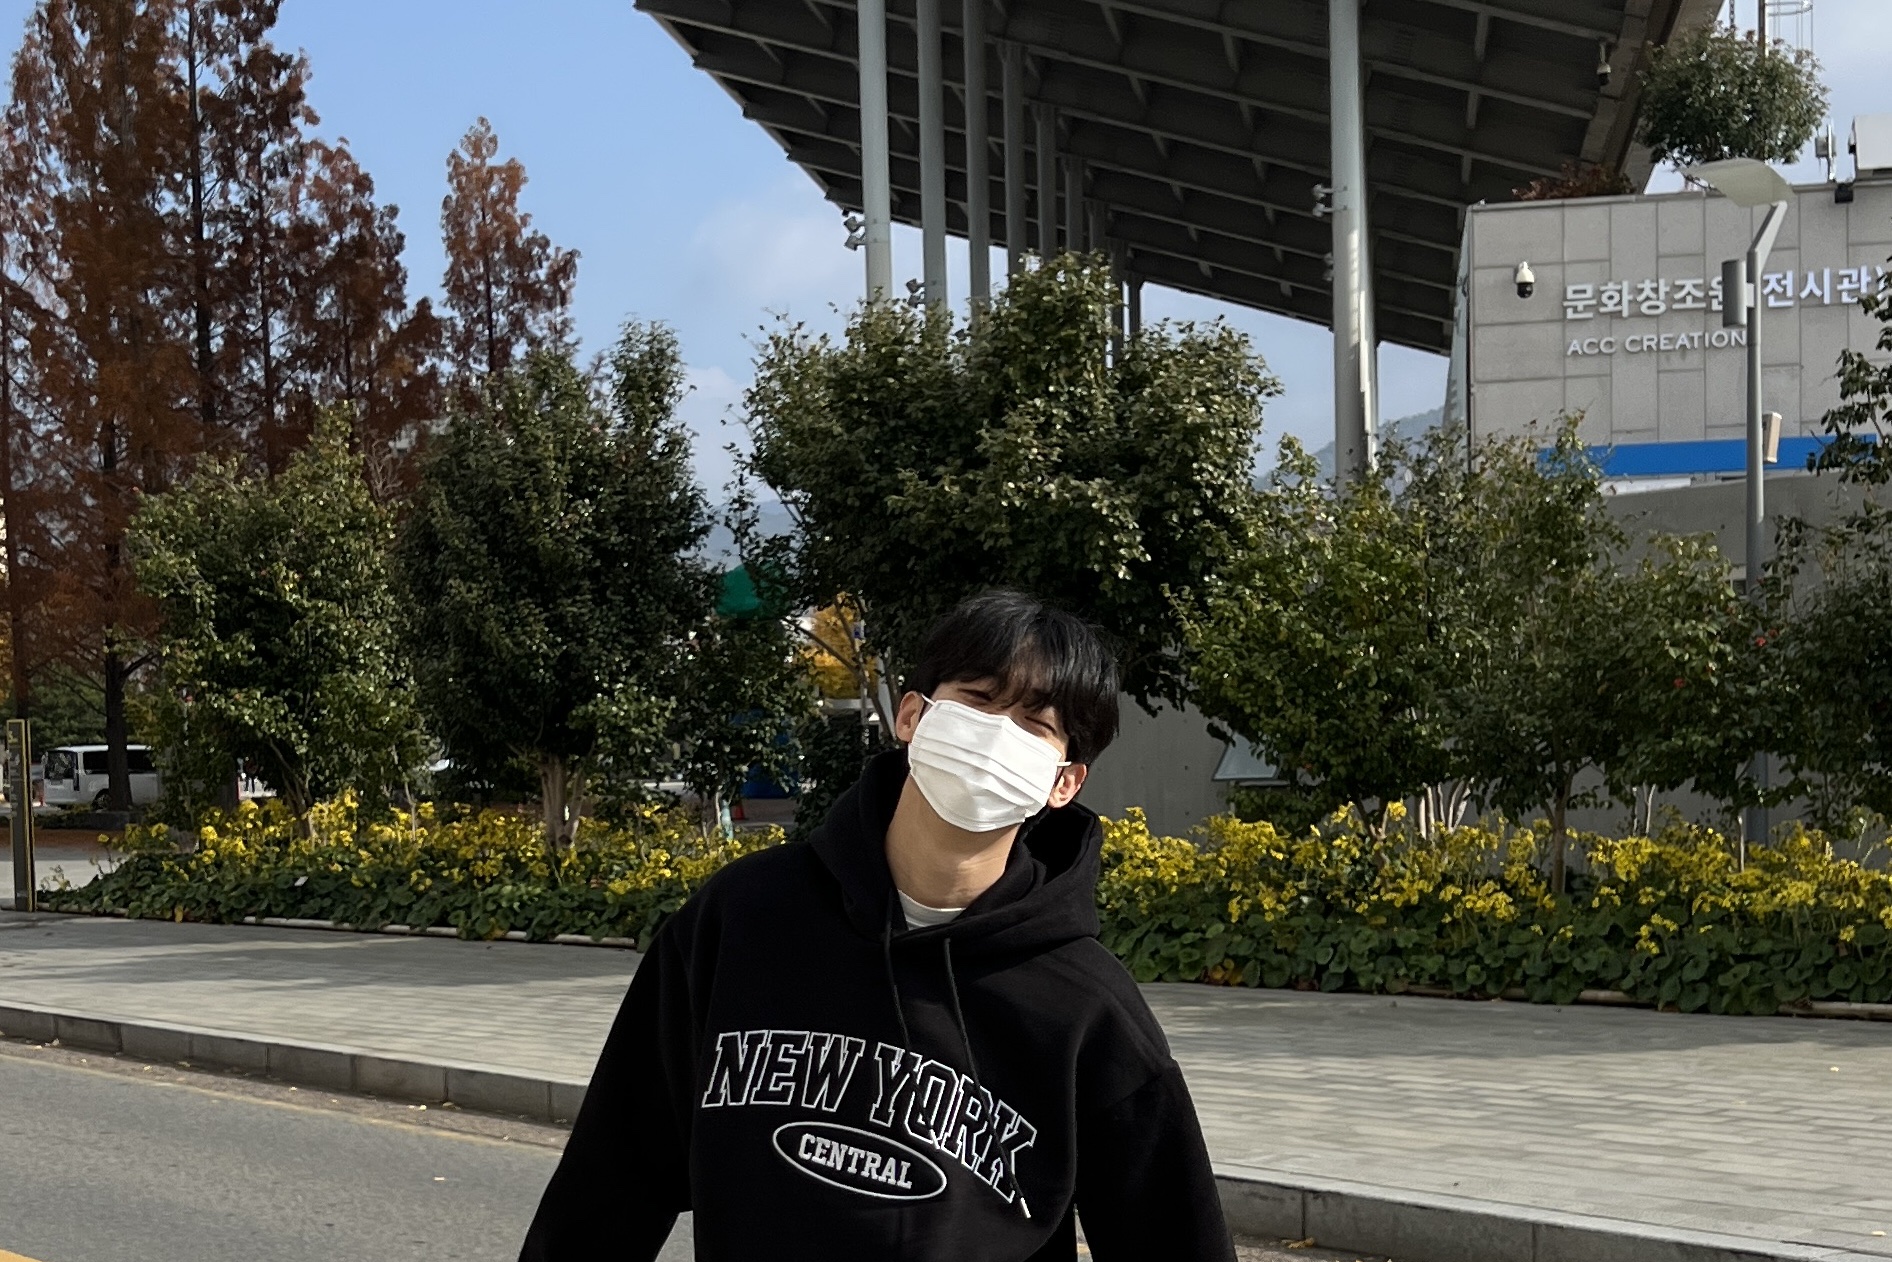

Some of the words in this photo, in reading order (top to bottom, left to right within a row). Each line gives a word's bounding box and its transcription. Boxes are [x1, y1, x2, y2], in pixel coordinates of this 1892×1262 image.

[1567, 337, 1616, 356] ACC
[1625, 330, 1747, 352] CREATION
[701, 1029, 866, 1112] NEW
[869, 1041, 1038, 1204] YORK
[798, 1132, 913, 1190] CENTRAL
